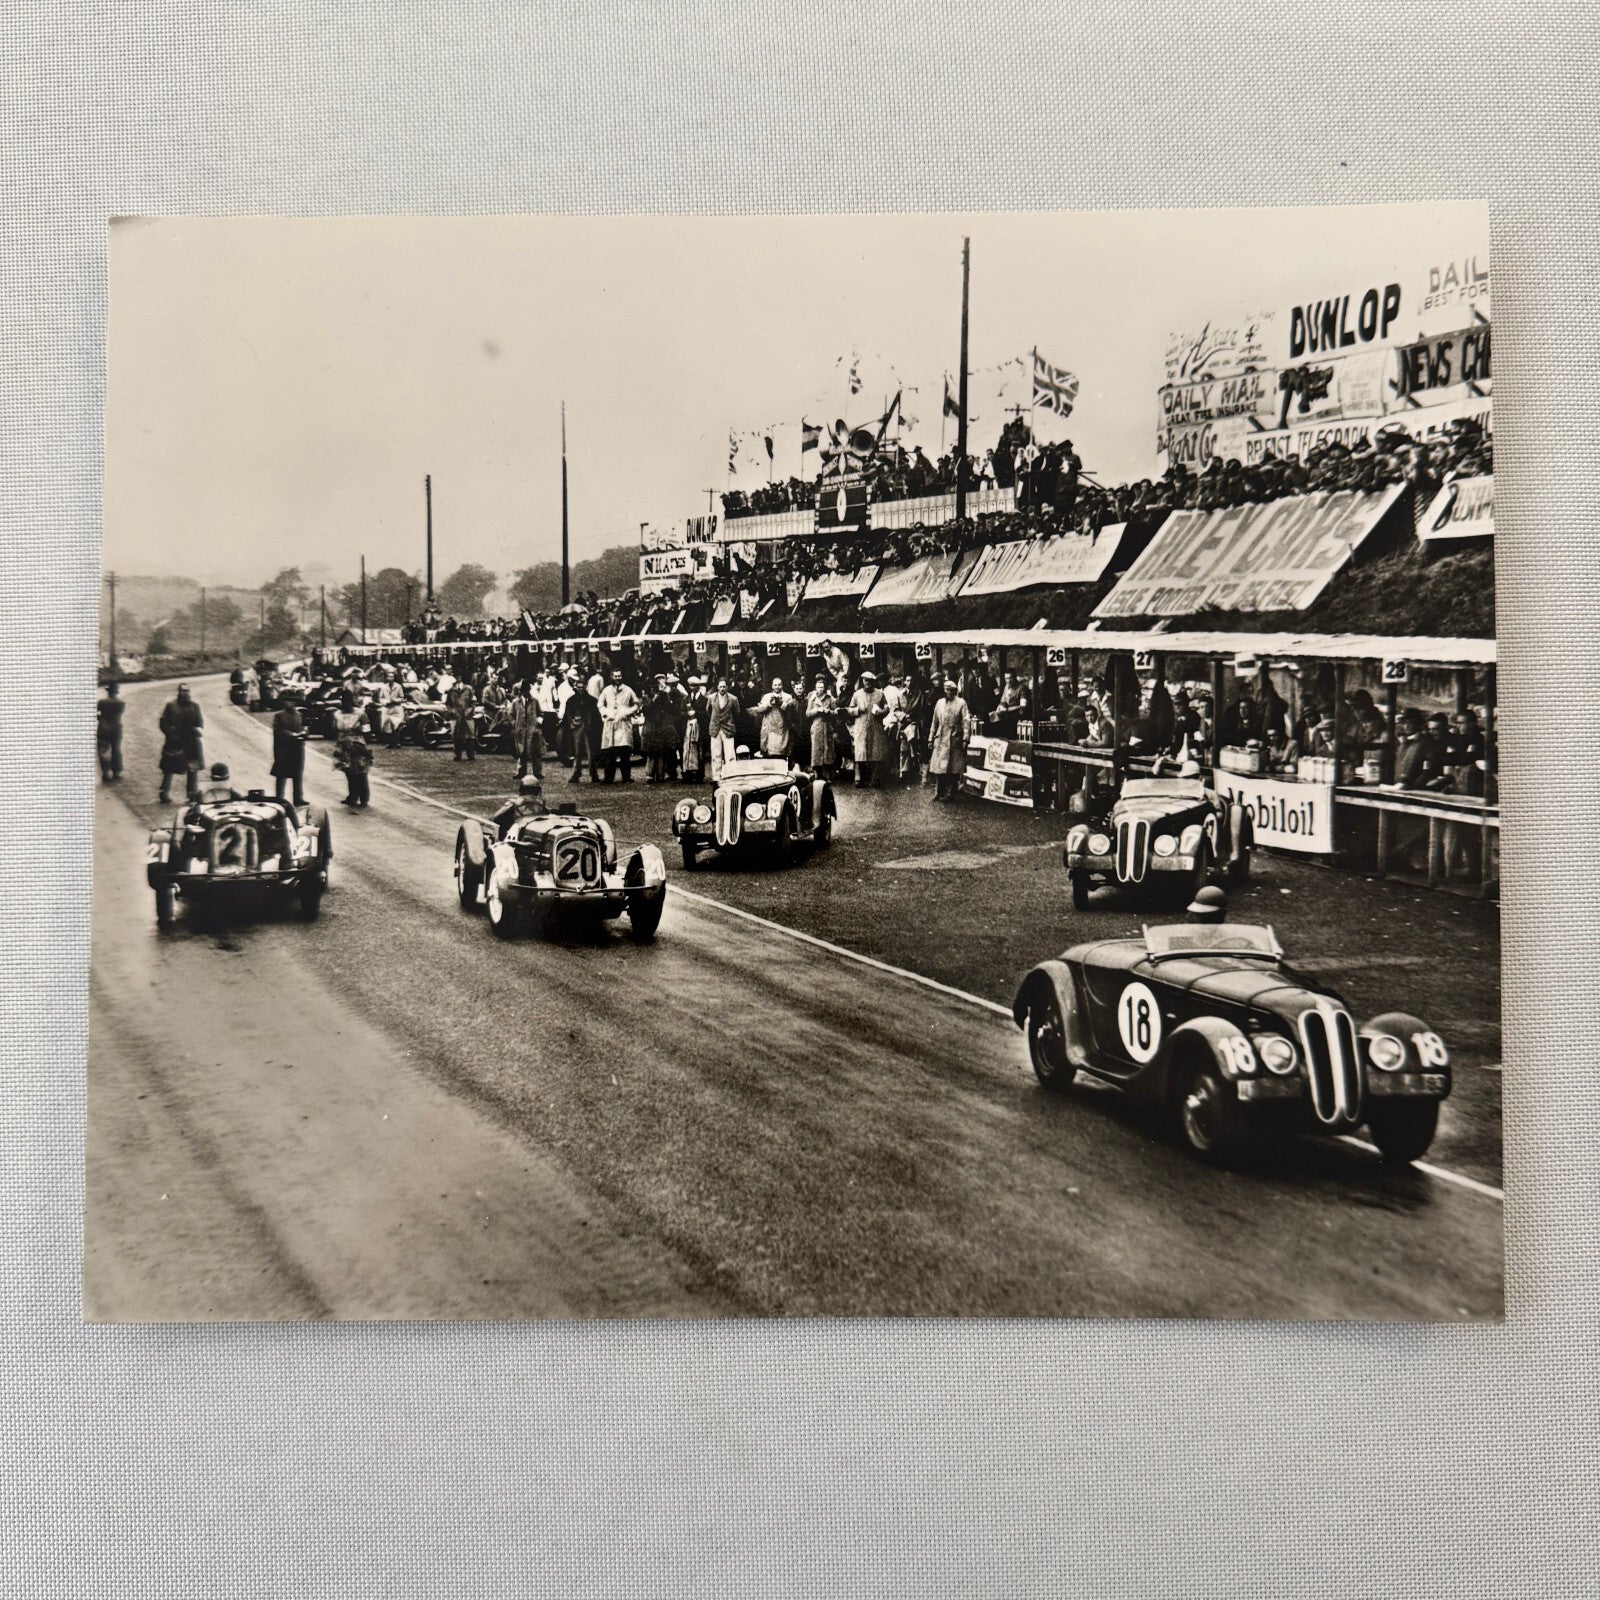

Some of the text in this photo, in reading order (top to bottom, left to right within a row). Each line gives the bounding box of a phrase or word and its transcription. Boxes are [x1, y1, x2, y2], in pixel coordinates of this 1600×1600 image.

[1423, 289, 1454, 310] BEST
[1289, 283, 1401, 358] DUNLOP
[1398, 340, 1454, 394] NEWS
[1162, 376, 1265, 415] DAILY MAIL
[1127, 502, 1266, 581] RILEY
[1229, 488, 1386, 576] CARS
[696, 642, 705, 651] 21
[768, 643, 779, 654] 22
[807, 644, 819, 655] 23
[860, 644, 873, 656] 24
[916, 645, 930, 657] 25
[1049, 649, 1064, 662] 26
[1136, 651, 1151, 666] 27
[677, 805, 690, 821] 19
[149, 842, 170, 863] 21
[219, 825, 259, 868] 21
[298, 835, 319, 857] 21
[557, 847, 598, 882] 20
[1126, 995, 1151, 1051] 18
[1217, 1036, 1257, 1074] 18
[1410, 1031, 1449, 1068] 18
